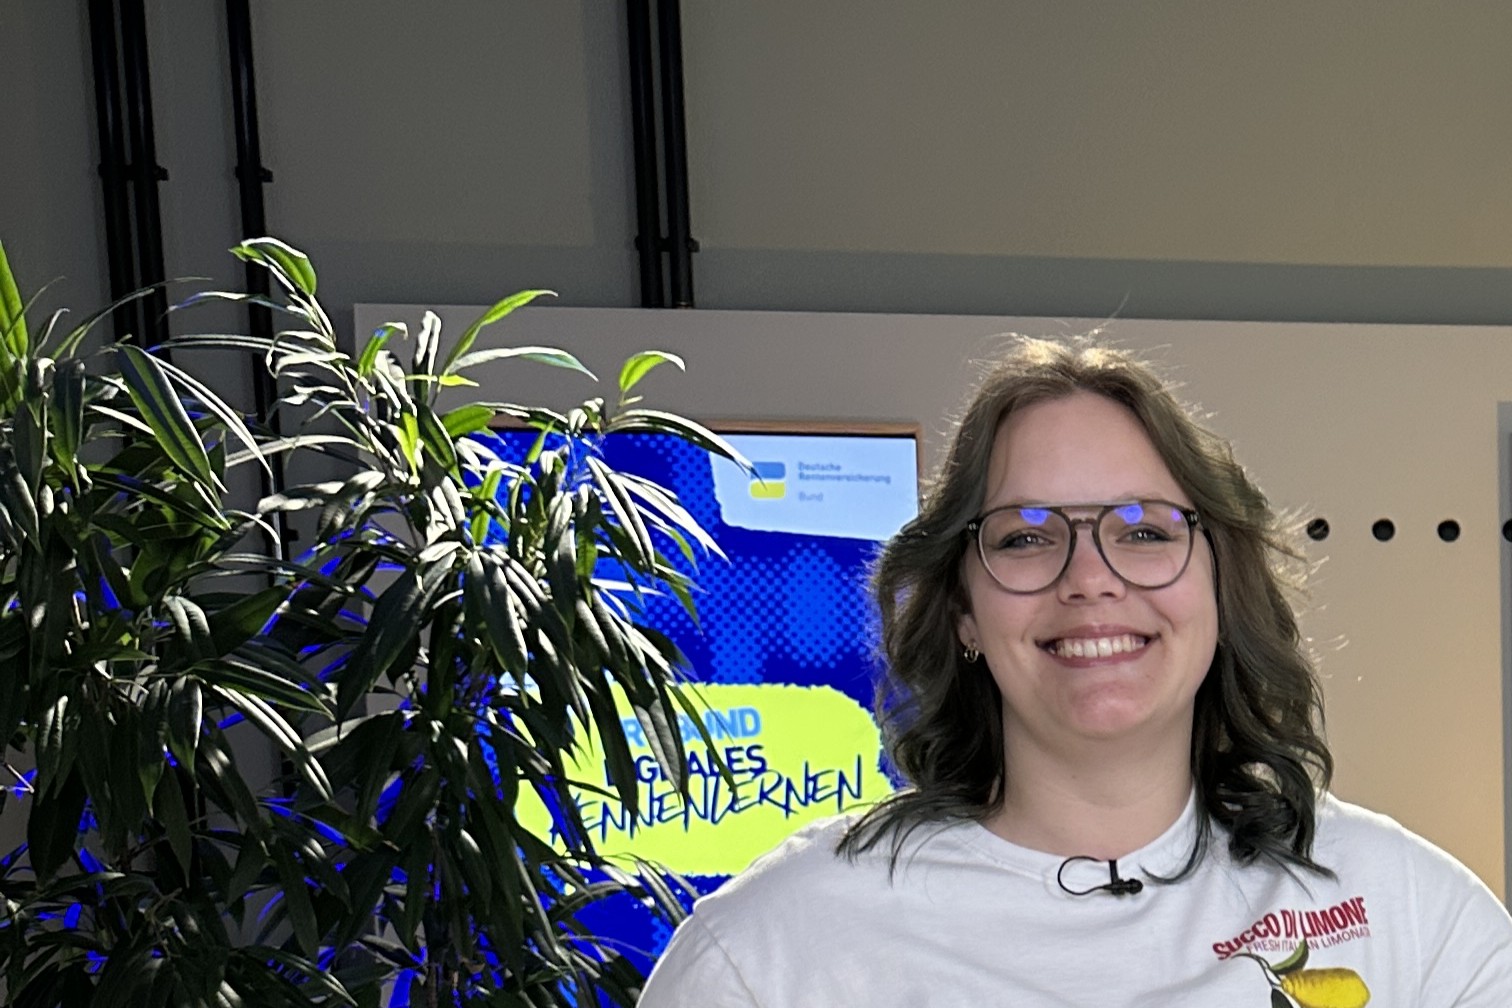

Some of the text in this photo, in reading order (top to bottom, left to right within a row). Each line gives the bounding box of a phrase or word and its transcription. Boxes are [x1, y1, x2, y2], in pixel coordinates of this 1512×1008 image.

[798, 461, 842, 471] Deutsche
[798, 472, 891, 484] Rentenversicherung
[1212, 912, 1281, 961] SUCCO
[1280, 909, 1299, 939] DI
